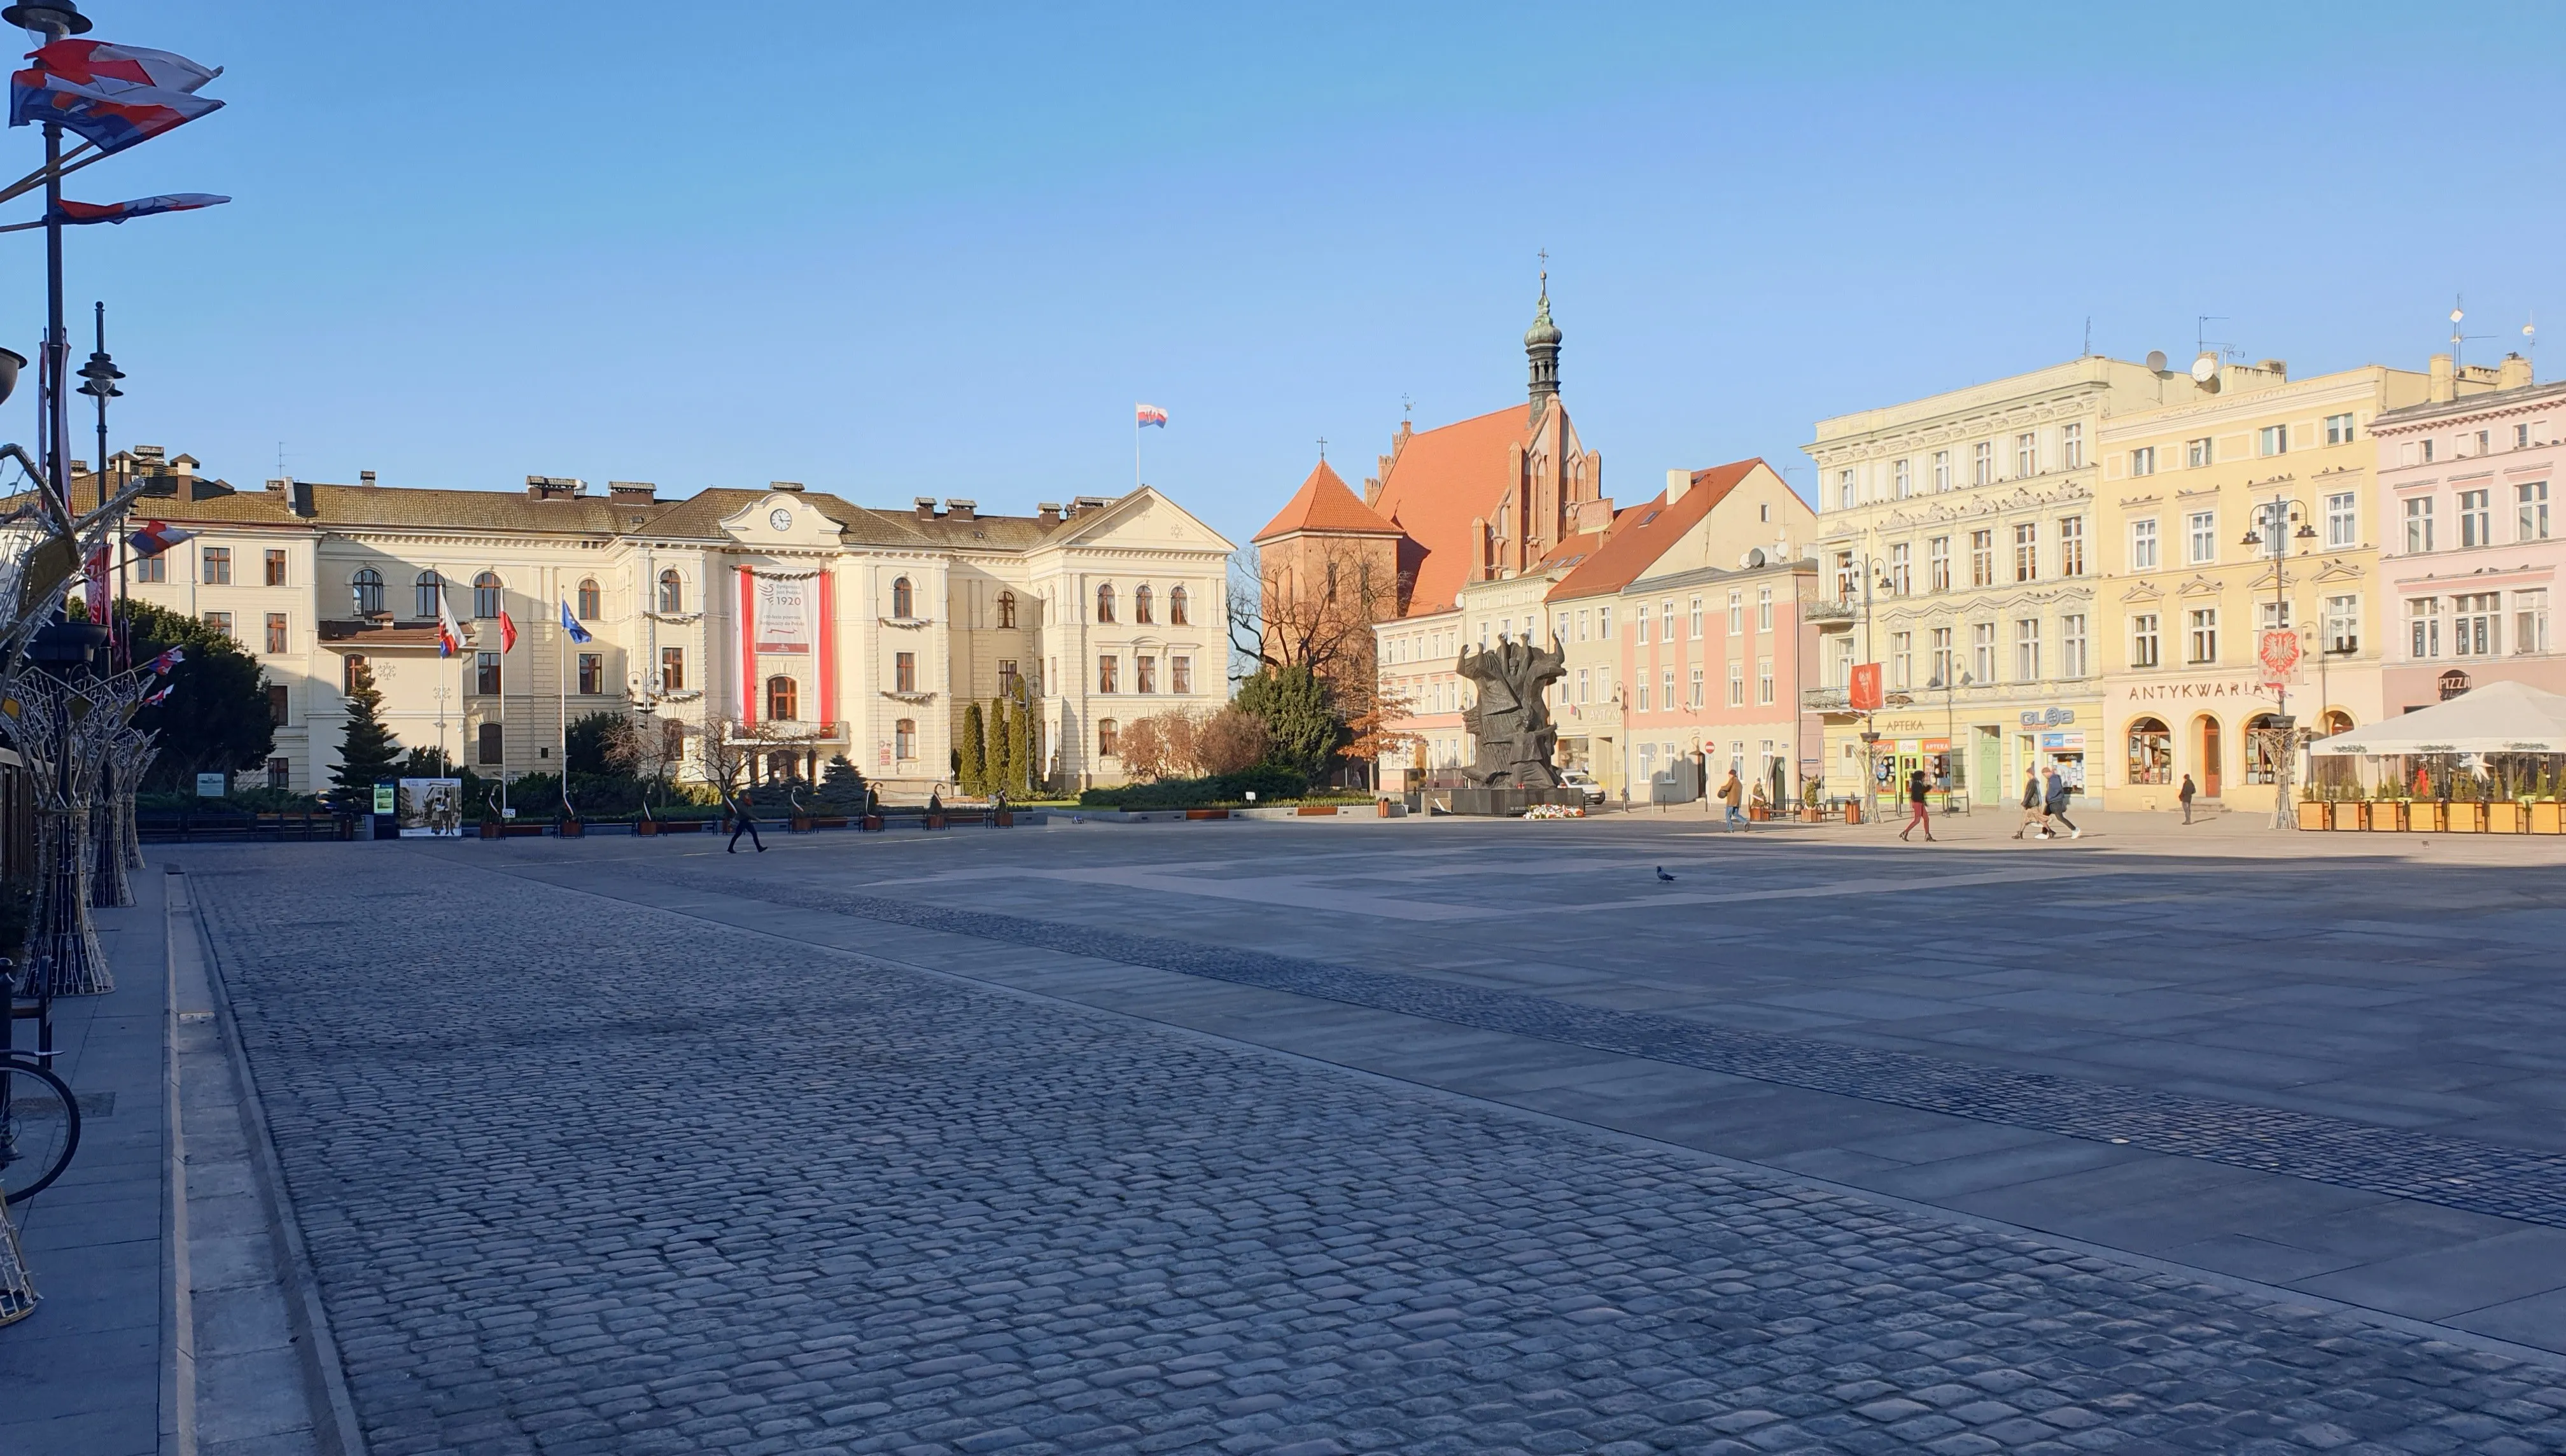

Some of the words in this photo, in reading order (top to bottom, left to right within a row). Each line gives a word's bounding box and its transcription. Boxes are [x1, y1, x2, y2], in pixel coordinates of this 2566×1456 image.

[776, 596, 801, 605] 1920
[2439, 676, 2471, 690] PIZZA
[2020, 708, 2075, 727] GLOB
[1886, 720, 1924, 732] APTEKA
